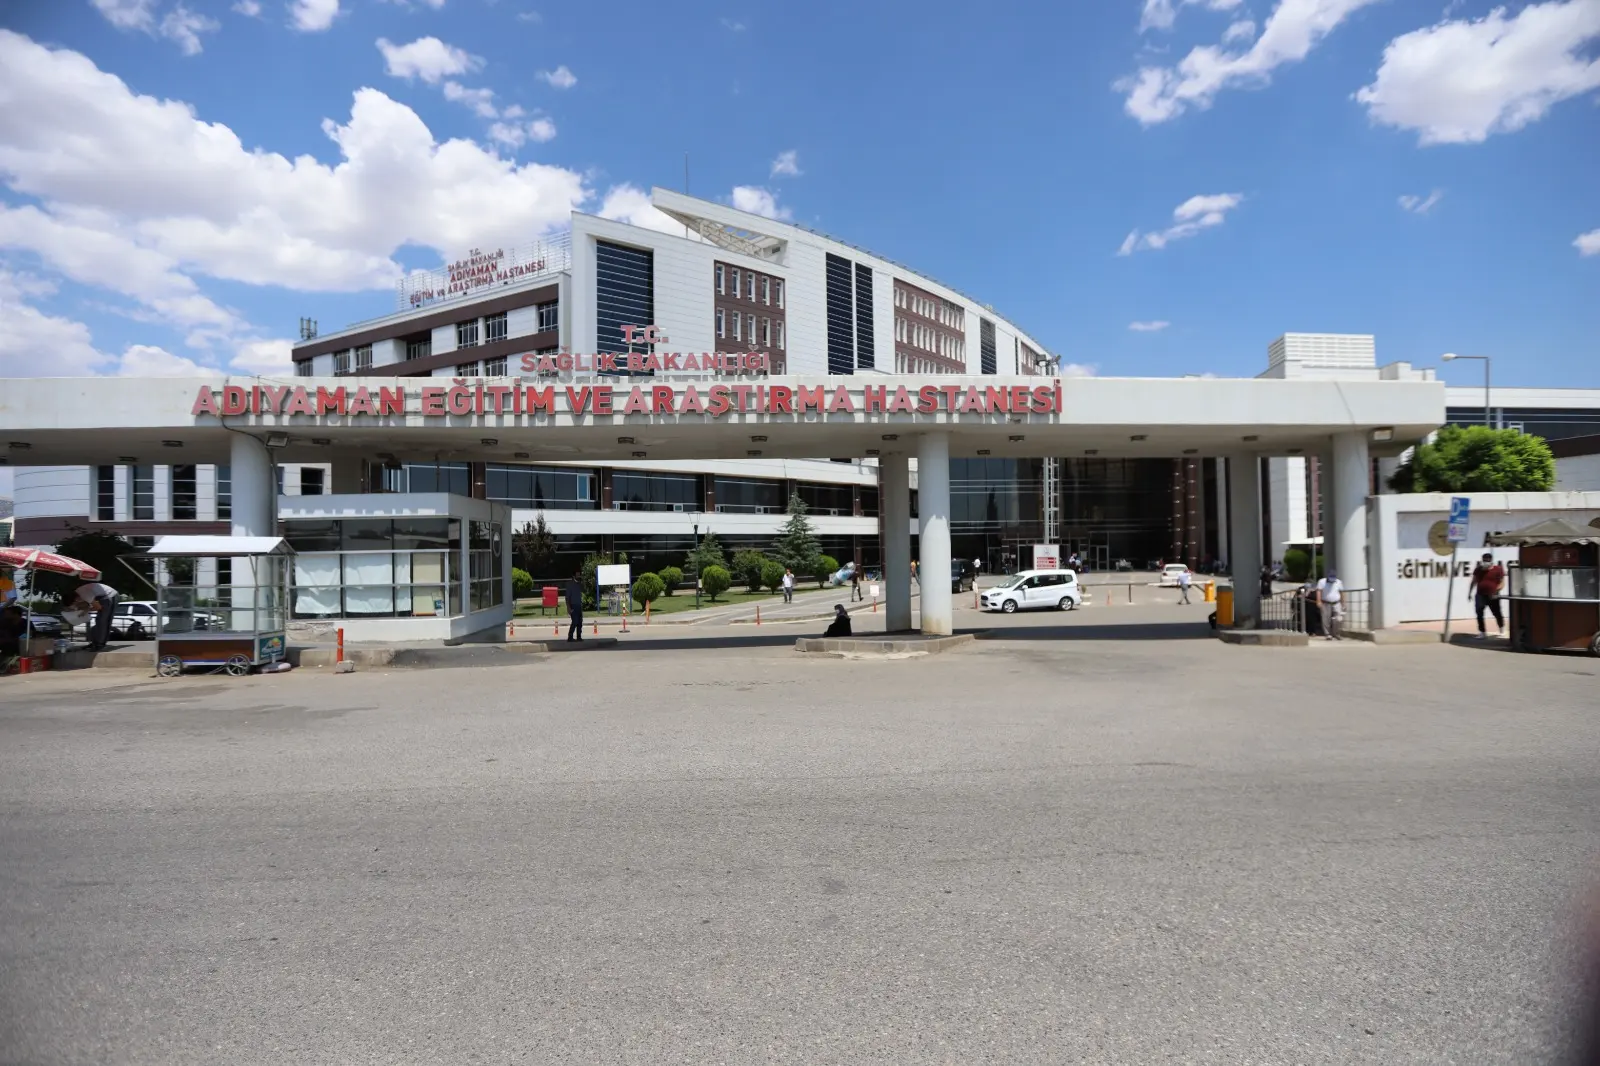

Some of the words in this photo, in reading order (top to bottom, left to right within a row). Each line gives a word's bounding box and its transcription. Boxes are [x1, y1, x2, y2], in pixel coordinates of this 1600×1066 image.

[450, 261, 497, 283] ADIYAMAN
[620, 324, 669, 344] T.C.
[519, 345, 619, 372] SAĞLIK
[627, 344, 770, 371] BAKANLIĞI
[191, 385, 405, 416] ADIYAMAN
[421, 377, 556, 416] EĞİTİM
[565, 385, 614, 415] VE
[623, 384, 855, 418] ARAŞTIRMA
[864, 378, 1063, 414] HASTANESİ
